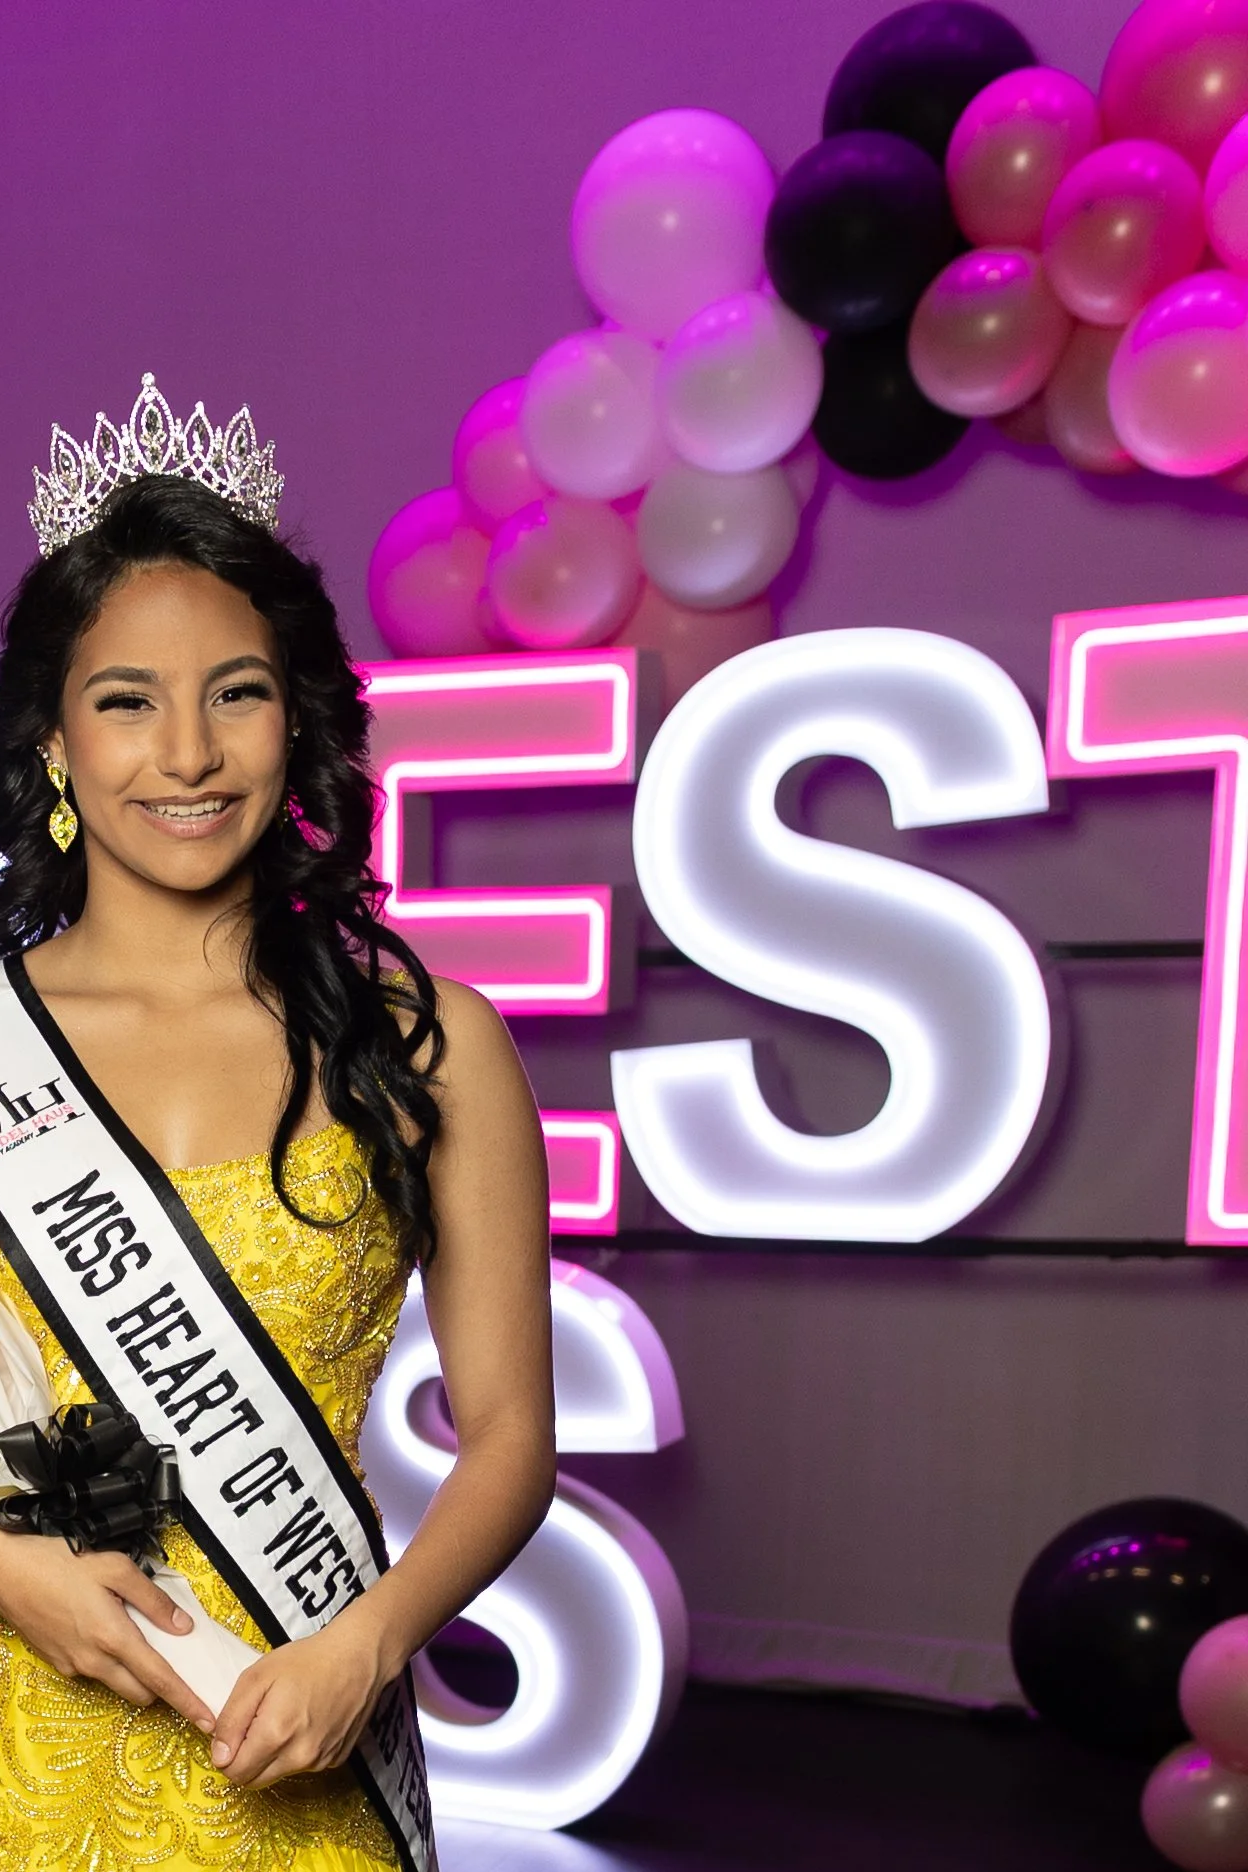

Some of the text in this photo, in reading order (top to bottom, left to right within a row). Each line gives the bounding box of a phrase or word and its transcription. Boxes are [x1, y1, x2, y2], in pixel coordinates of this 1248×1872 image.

[32, 1103, 75, 1127] HAUS
[5, 1132, 34, 1153] ACADEMY
[31, 1169, 153, 1297] MISS
[106, 1281, 265, 1457] HEART
[219, 1446, 304, 1518] OF
